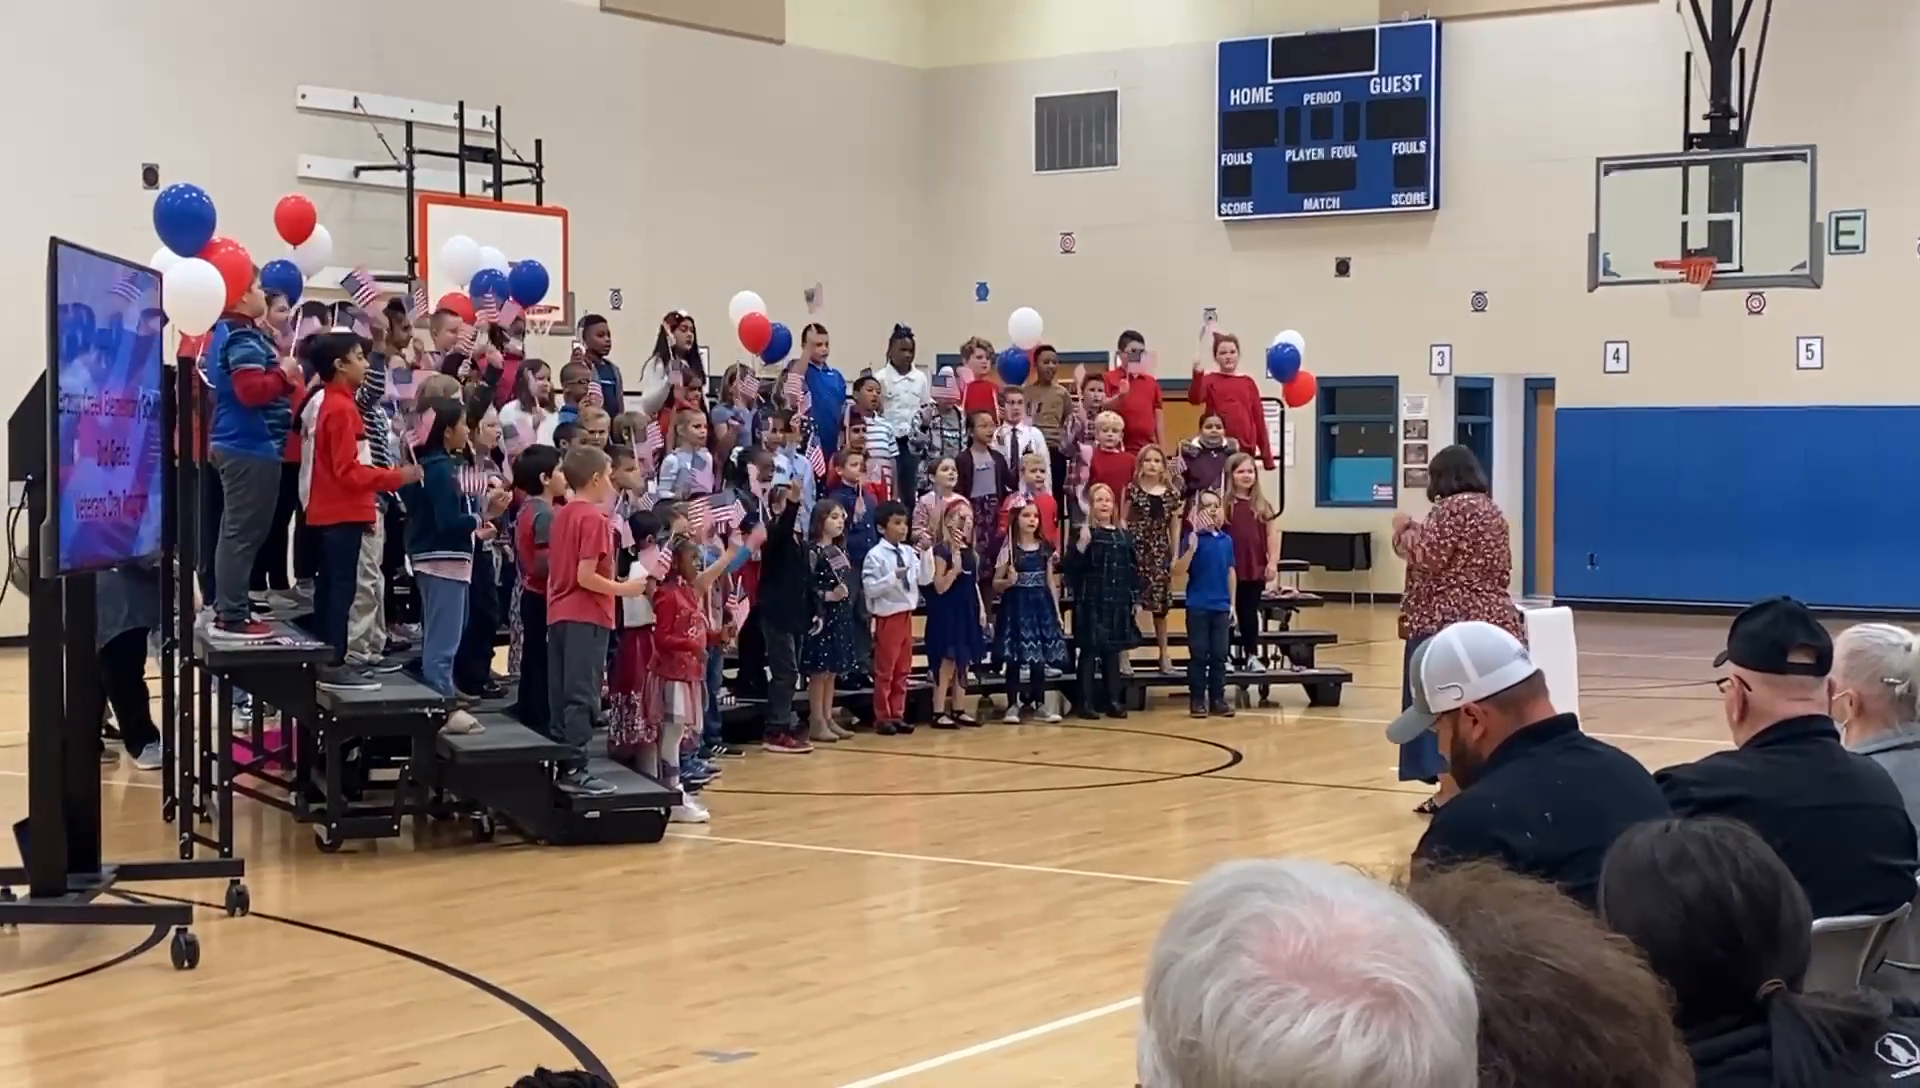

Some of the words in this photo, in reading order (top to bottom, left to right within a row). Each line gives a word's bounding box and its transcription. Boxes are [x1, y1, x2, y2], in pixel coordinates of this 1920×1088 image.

[1370, 74, 1422, 94] GUEST
[1230, 86, 1274, 105] HOME
[1303, 91, 1341, 106] PERIOD
[1285, 148, 1325, 162] PLAYER
[1330, 145, 1358, 159] FOUL
[1392, 140, 1427, 155] FOULS
[1221, 152, 1253, 165] FOULS
[1303, 197, 1341, 211] MATCH
[1391, 191, 1427, 206] SCORE
[1220, 201, 1254, 215] SCORE
[1834, 215, 1862, 250] E
[1437, 350, 1445, 367] 3
[1612, 347, 1621, 364] 4
[1805, 343, 1816, 361] 5
